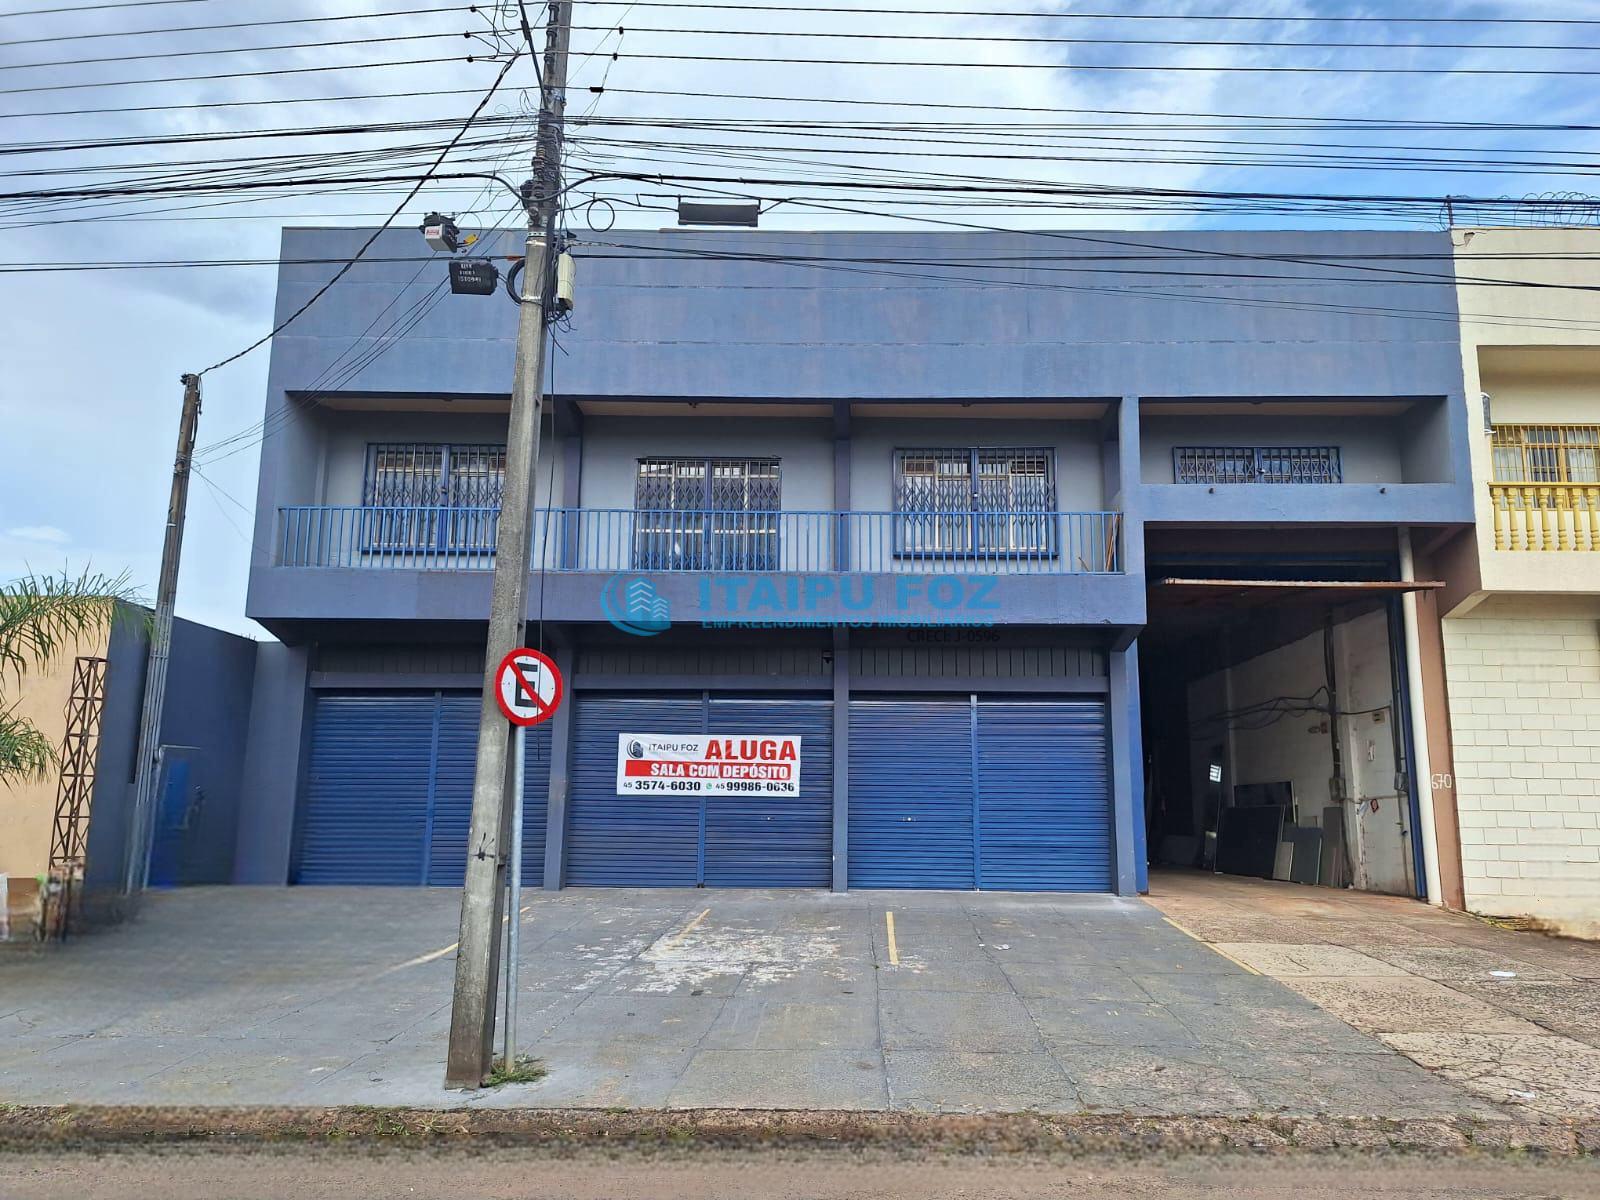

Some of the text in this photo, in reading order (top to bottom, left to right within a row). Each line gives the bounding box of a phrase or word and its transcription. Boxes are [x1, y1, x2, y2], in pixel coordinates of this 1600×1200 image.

[648, 743, 678, 752] ITAIPU
[680, 744, 699, 752] FOZ
[705, 739, 796, 761] ALUGA
[650, 762, 788, 779] SALA COM DEPÓSITO
[635, 780, 701, 790] 3574-6030
[726, 781, 795, 792] 99986-0636
